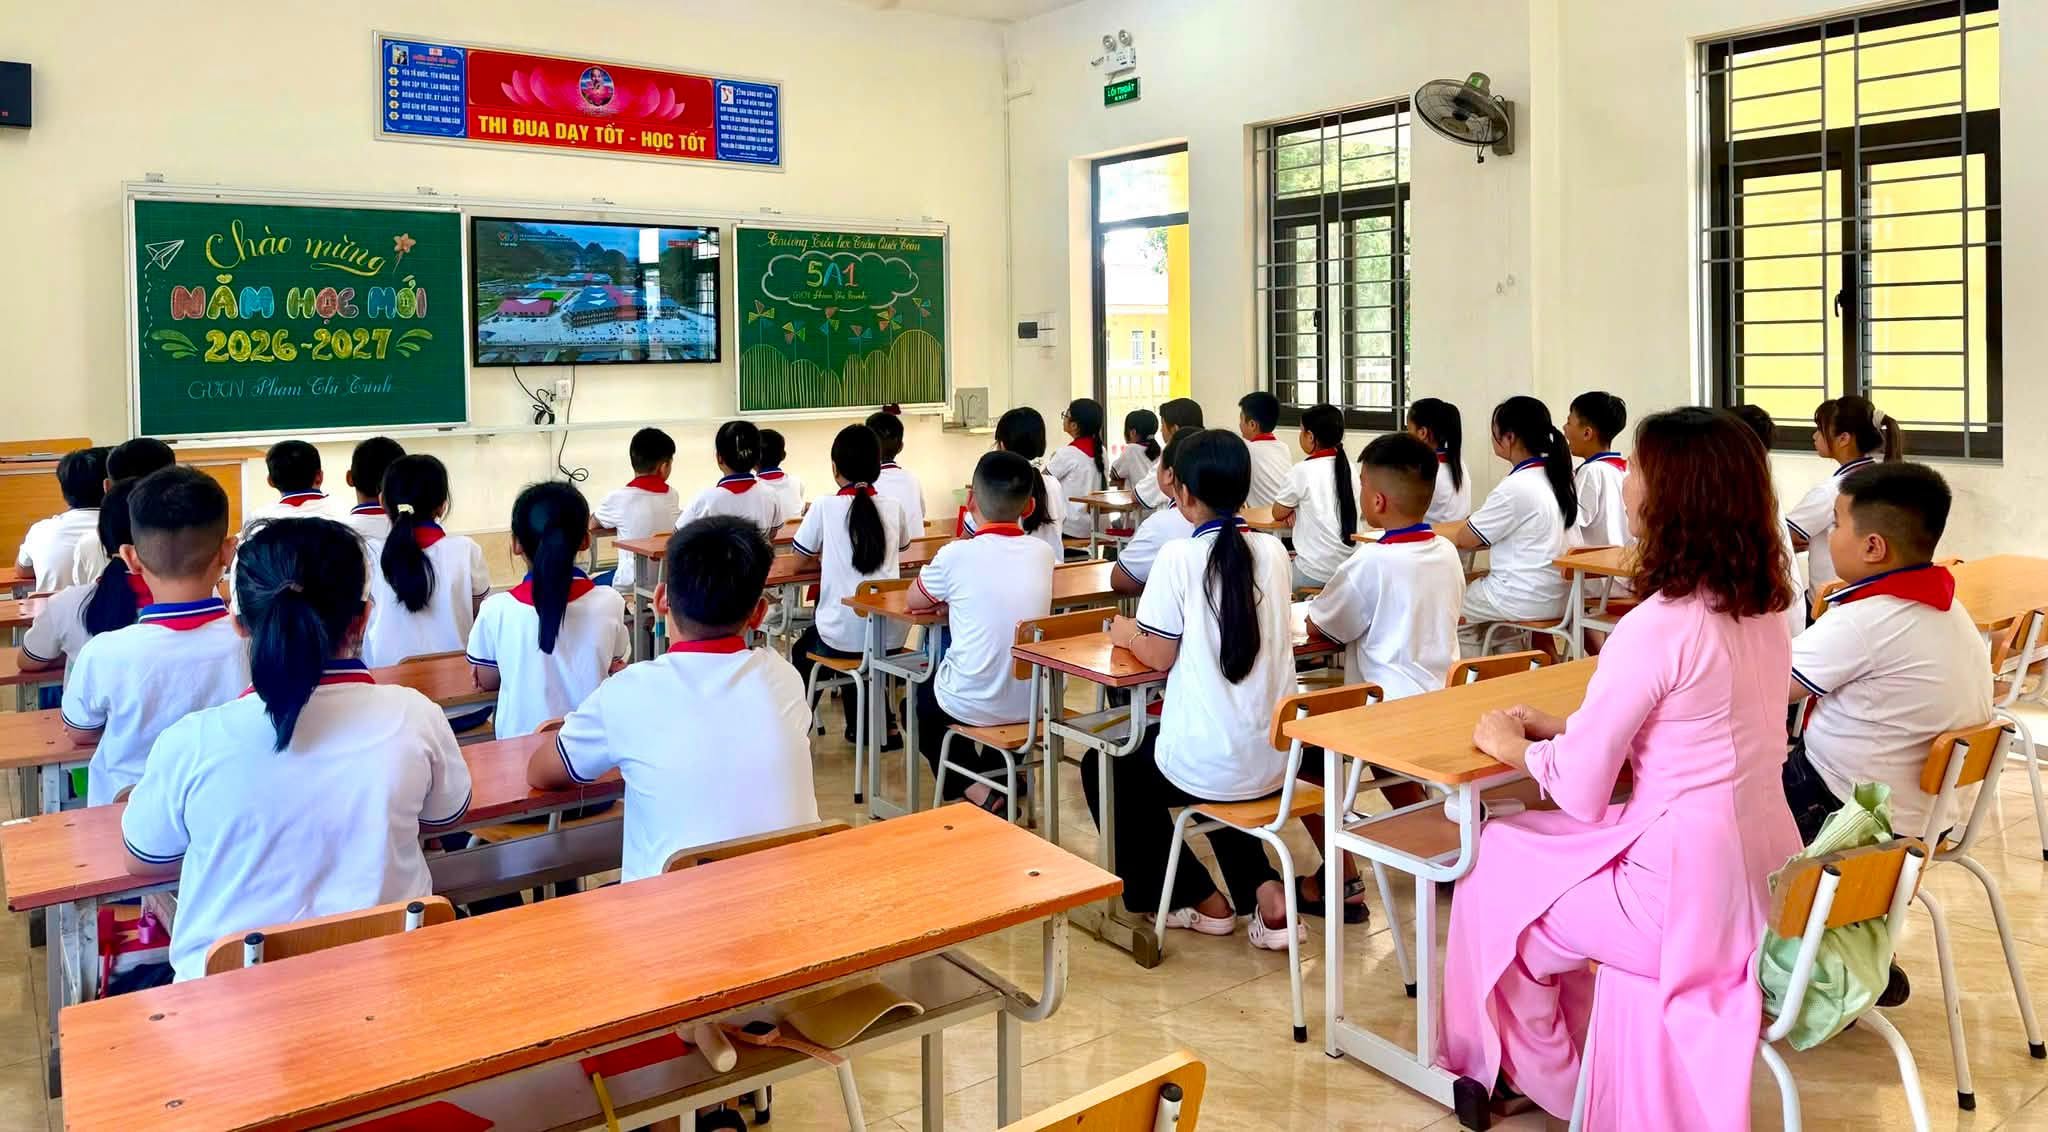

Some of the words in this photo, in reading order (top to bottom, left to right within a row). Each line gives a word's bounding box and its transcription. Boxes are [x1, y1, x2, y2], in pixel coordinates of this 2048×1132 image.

[478, 115, 507, 134] THI
[513, 118, 550, 137] ĐUA
[555, 123, 589, 144] DẠY
[594, 122, 625, 145] TỐT
[641, 131, 674, 151] HỌC
[678, 130, 707, 152] TỐT
[205, 219, 292, 269] Chào
[305, 234, 386, 276] mừng
[806, 260, 859, 288] 5A1
[170, 273, 275, 320] NĂM
[286, 286, 360, 325] HỌC
[367, 275, 428, 320] MỚI
[204, 328, 393, 363] 2026-2027
